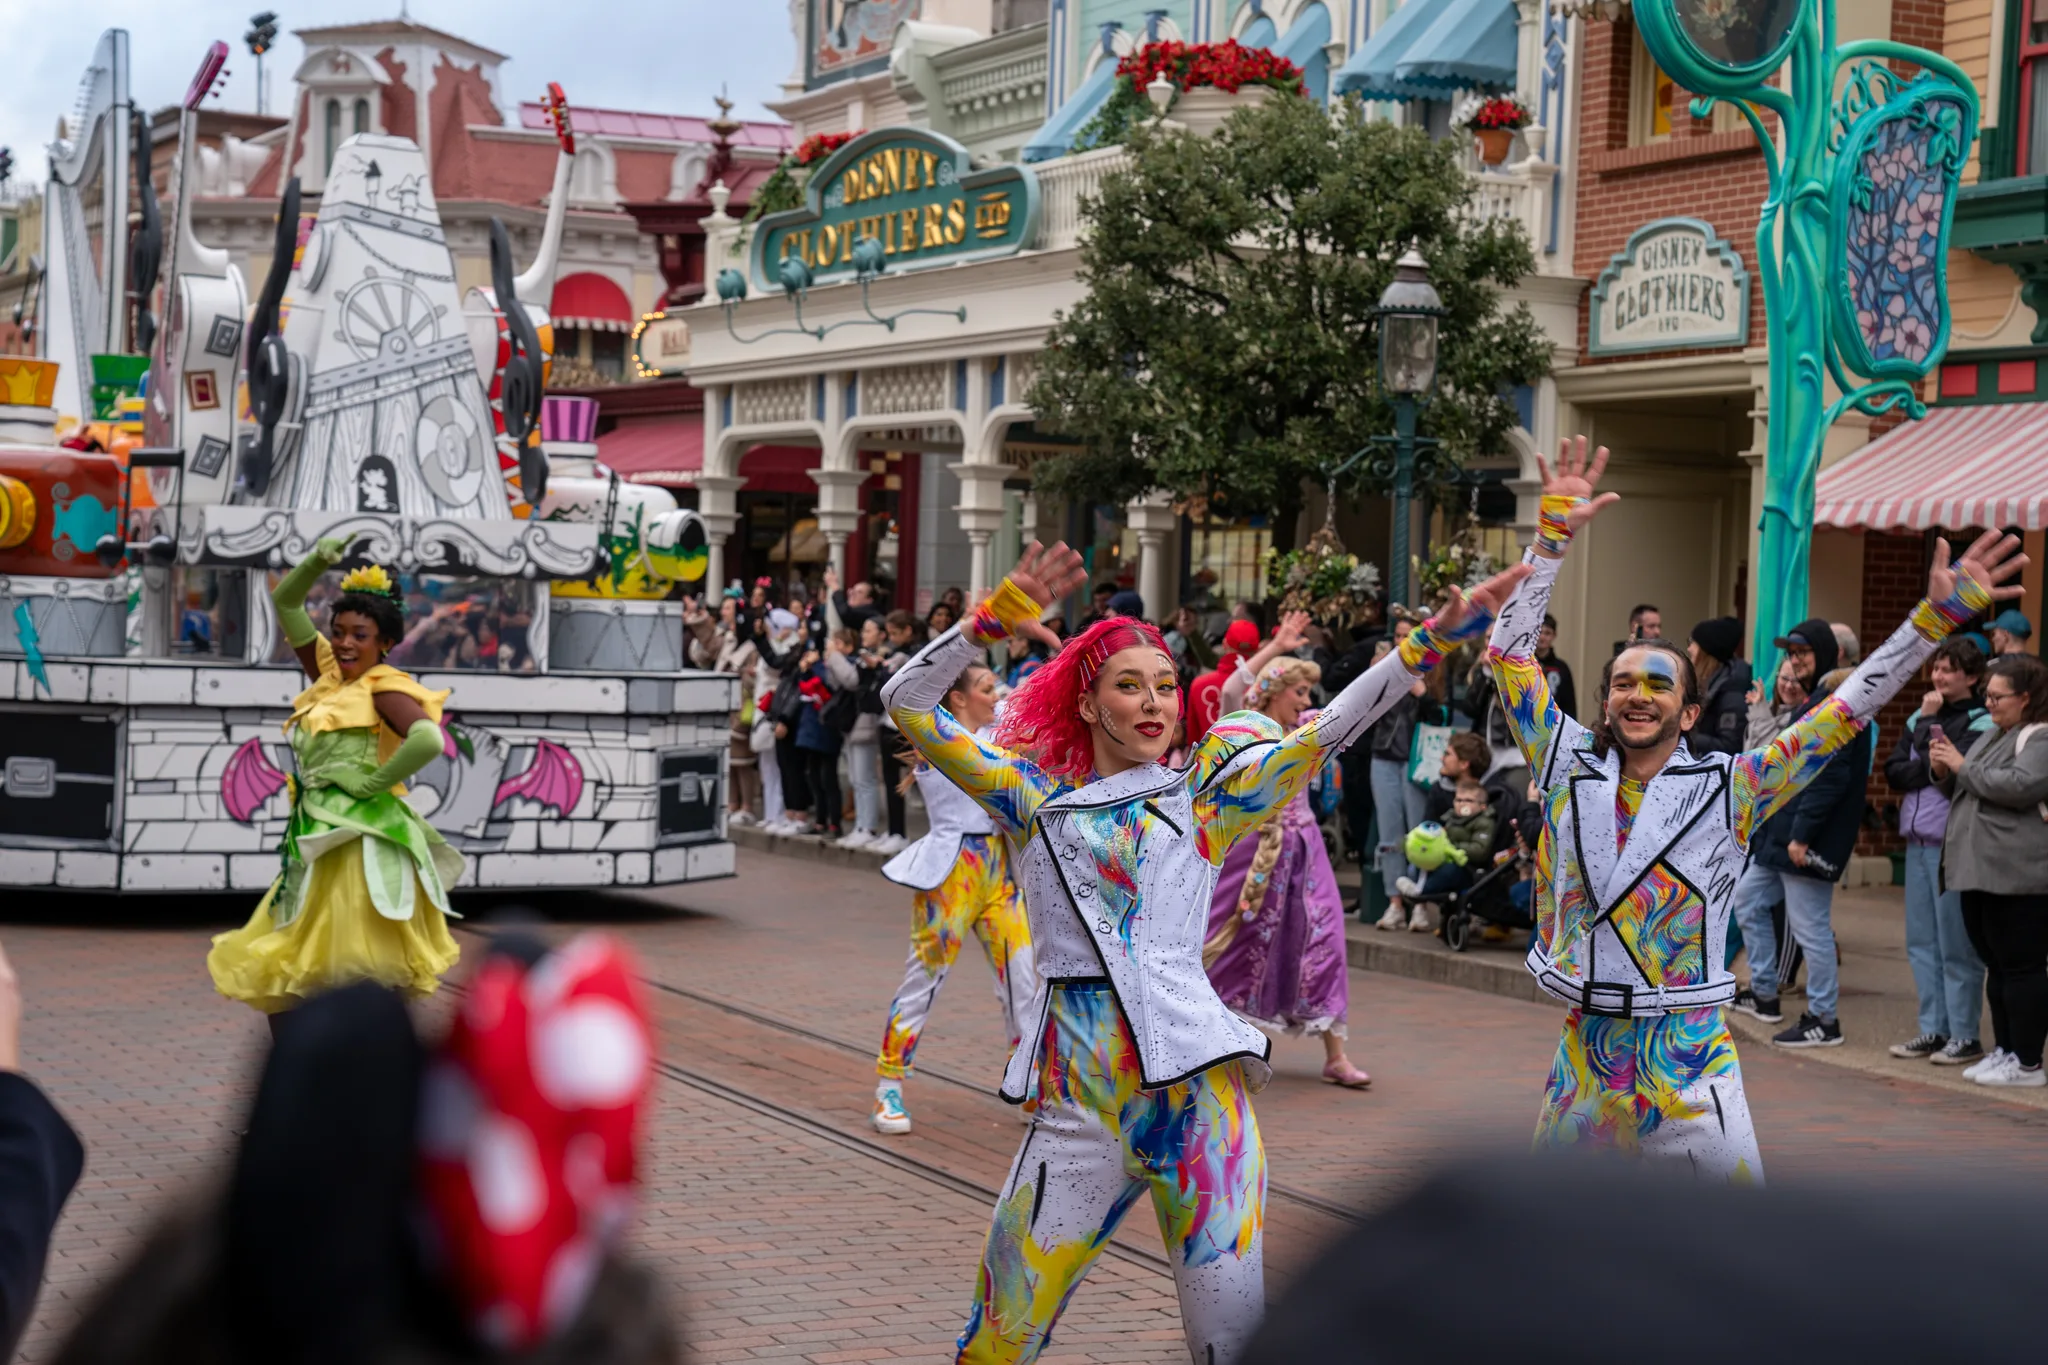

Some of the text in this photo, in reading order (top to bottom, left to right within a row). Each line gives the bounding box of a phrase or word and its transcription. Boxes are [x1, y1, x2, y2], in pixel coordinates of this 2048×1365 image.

[842, 148, 939, 205] DISNEY
[780, 199, 1011, 269] CLOTHIERS LTD
[1642, 236, 1704, 271] DISNEY
[1615, 273, 1726, 331] CLOTHIERS
